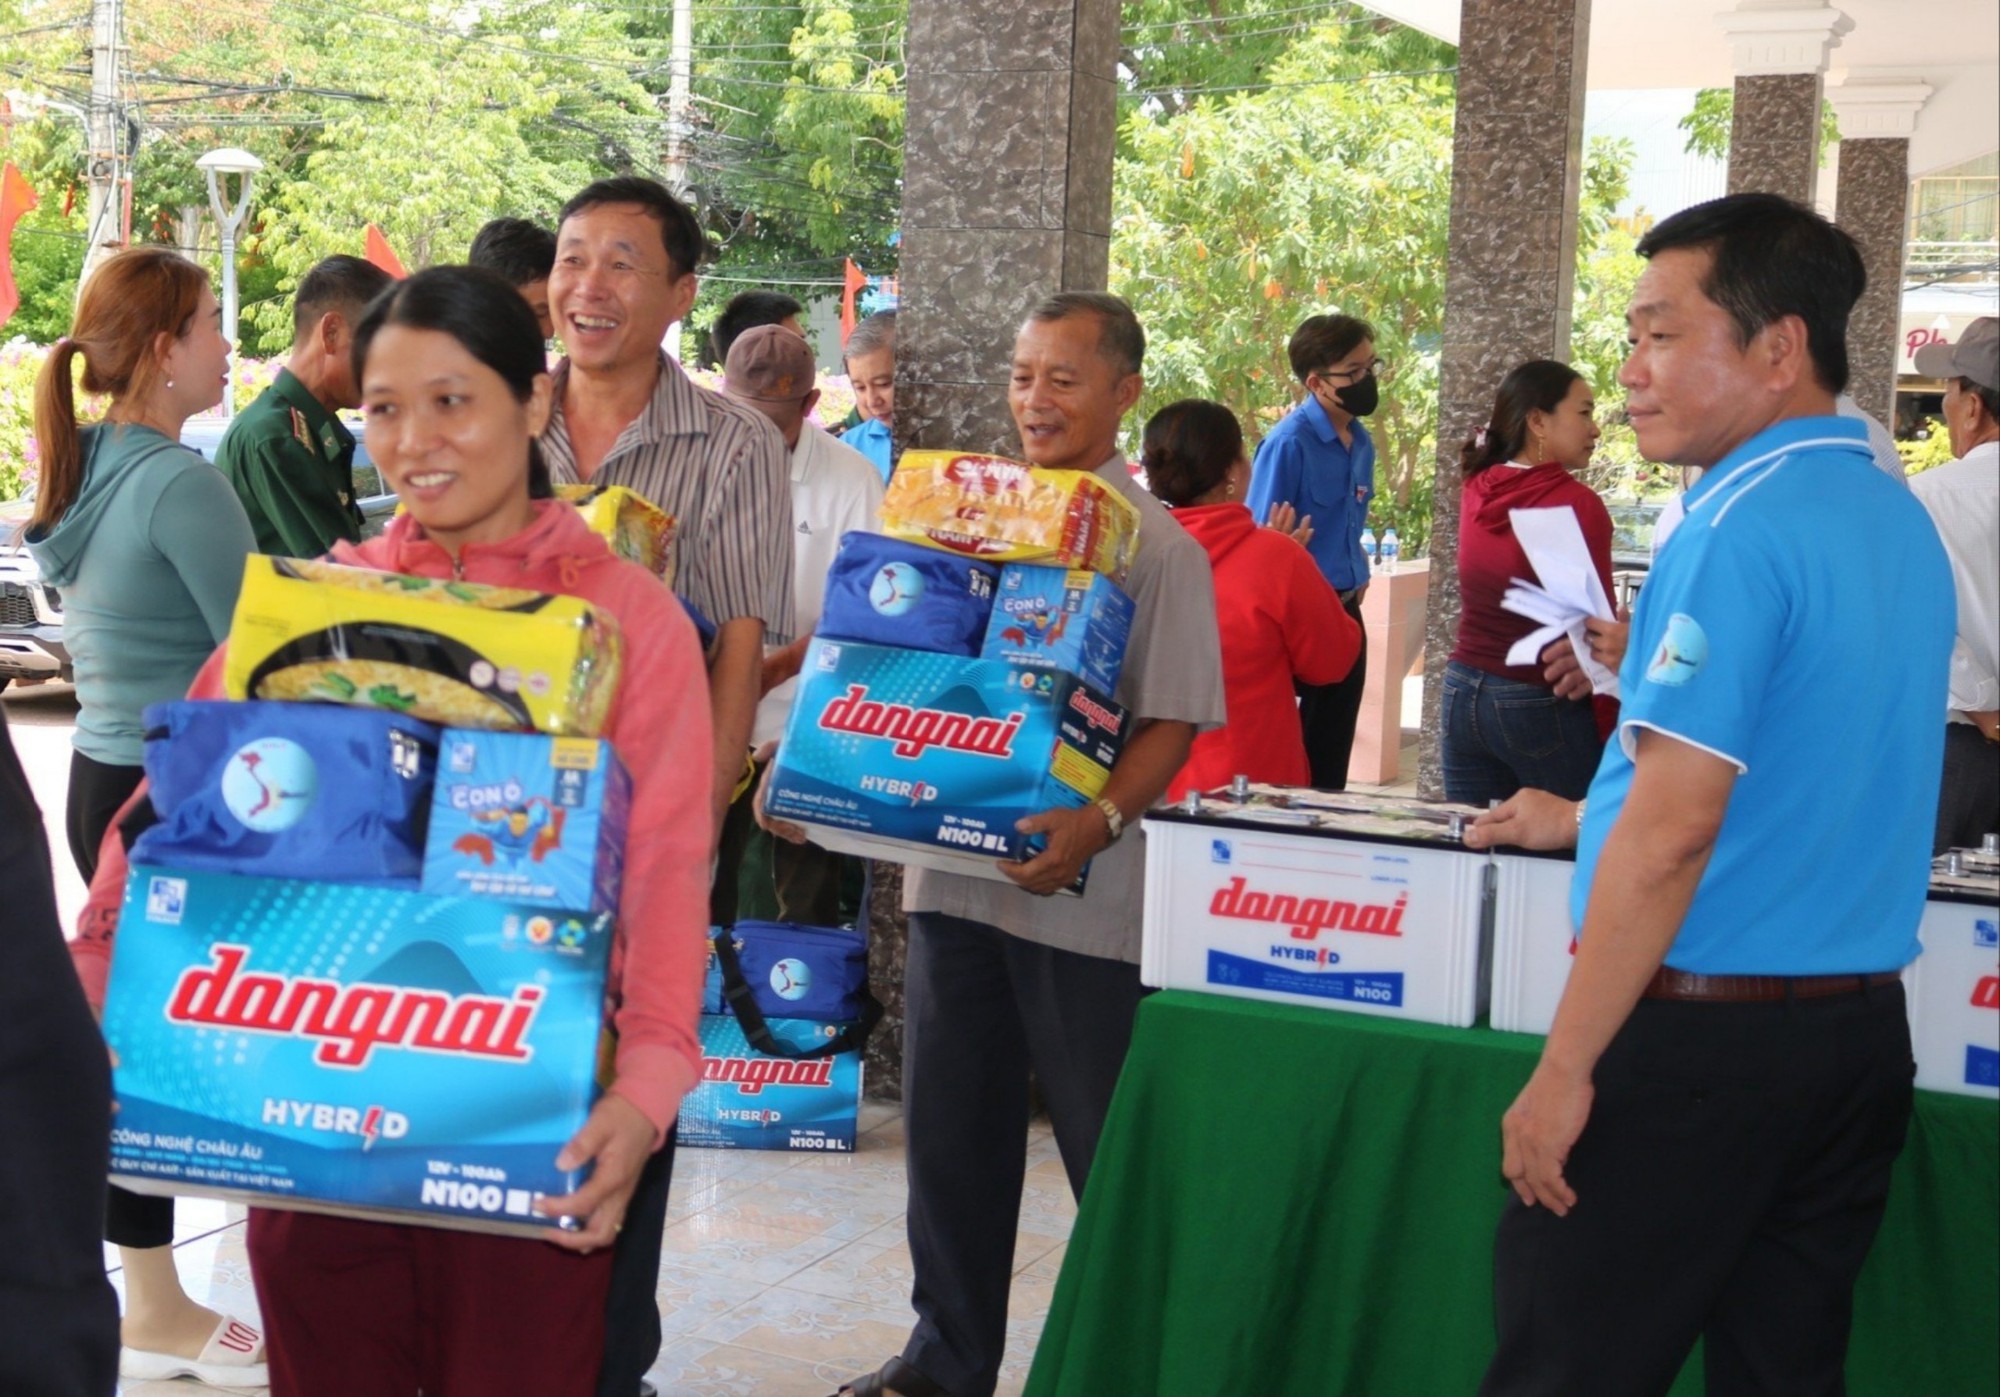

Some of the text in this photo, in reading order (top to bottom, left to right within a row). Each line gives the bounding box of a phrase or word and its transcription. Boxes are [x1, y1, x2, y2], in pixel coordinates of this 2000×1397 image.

[819, 684, 1025, 759] dongnai
[937, 825, 983, 848] N100
[1208, 876, 1408, 939] dongnai
[166, 943, 545, 1068] dongnai
[1353, 986, 1392, 1001] N100
[700, 1047, 833, 1094] ongnai
[789, 1137, 825, 1149] N100
[421, 1178, 503, 1213] N100
